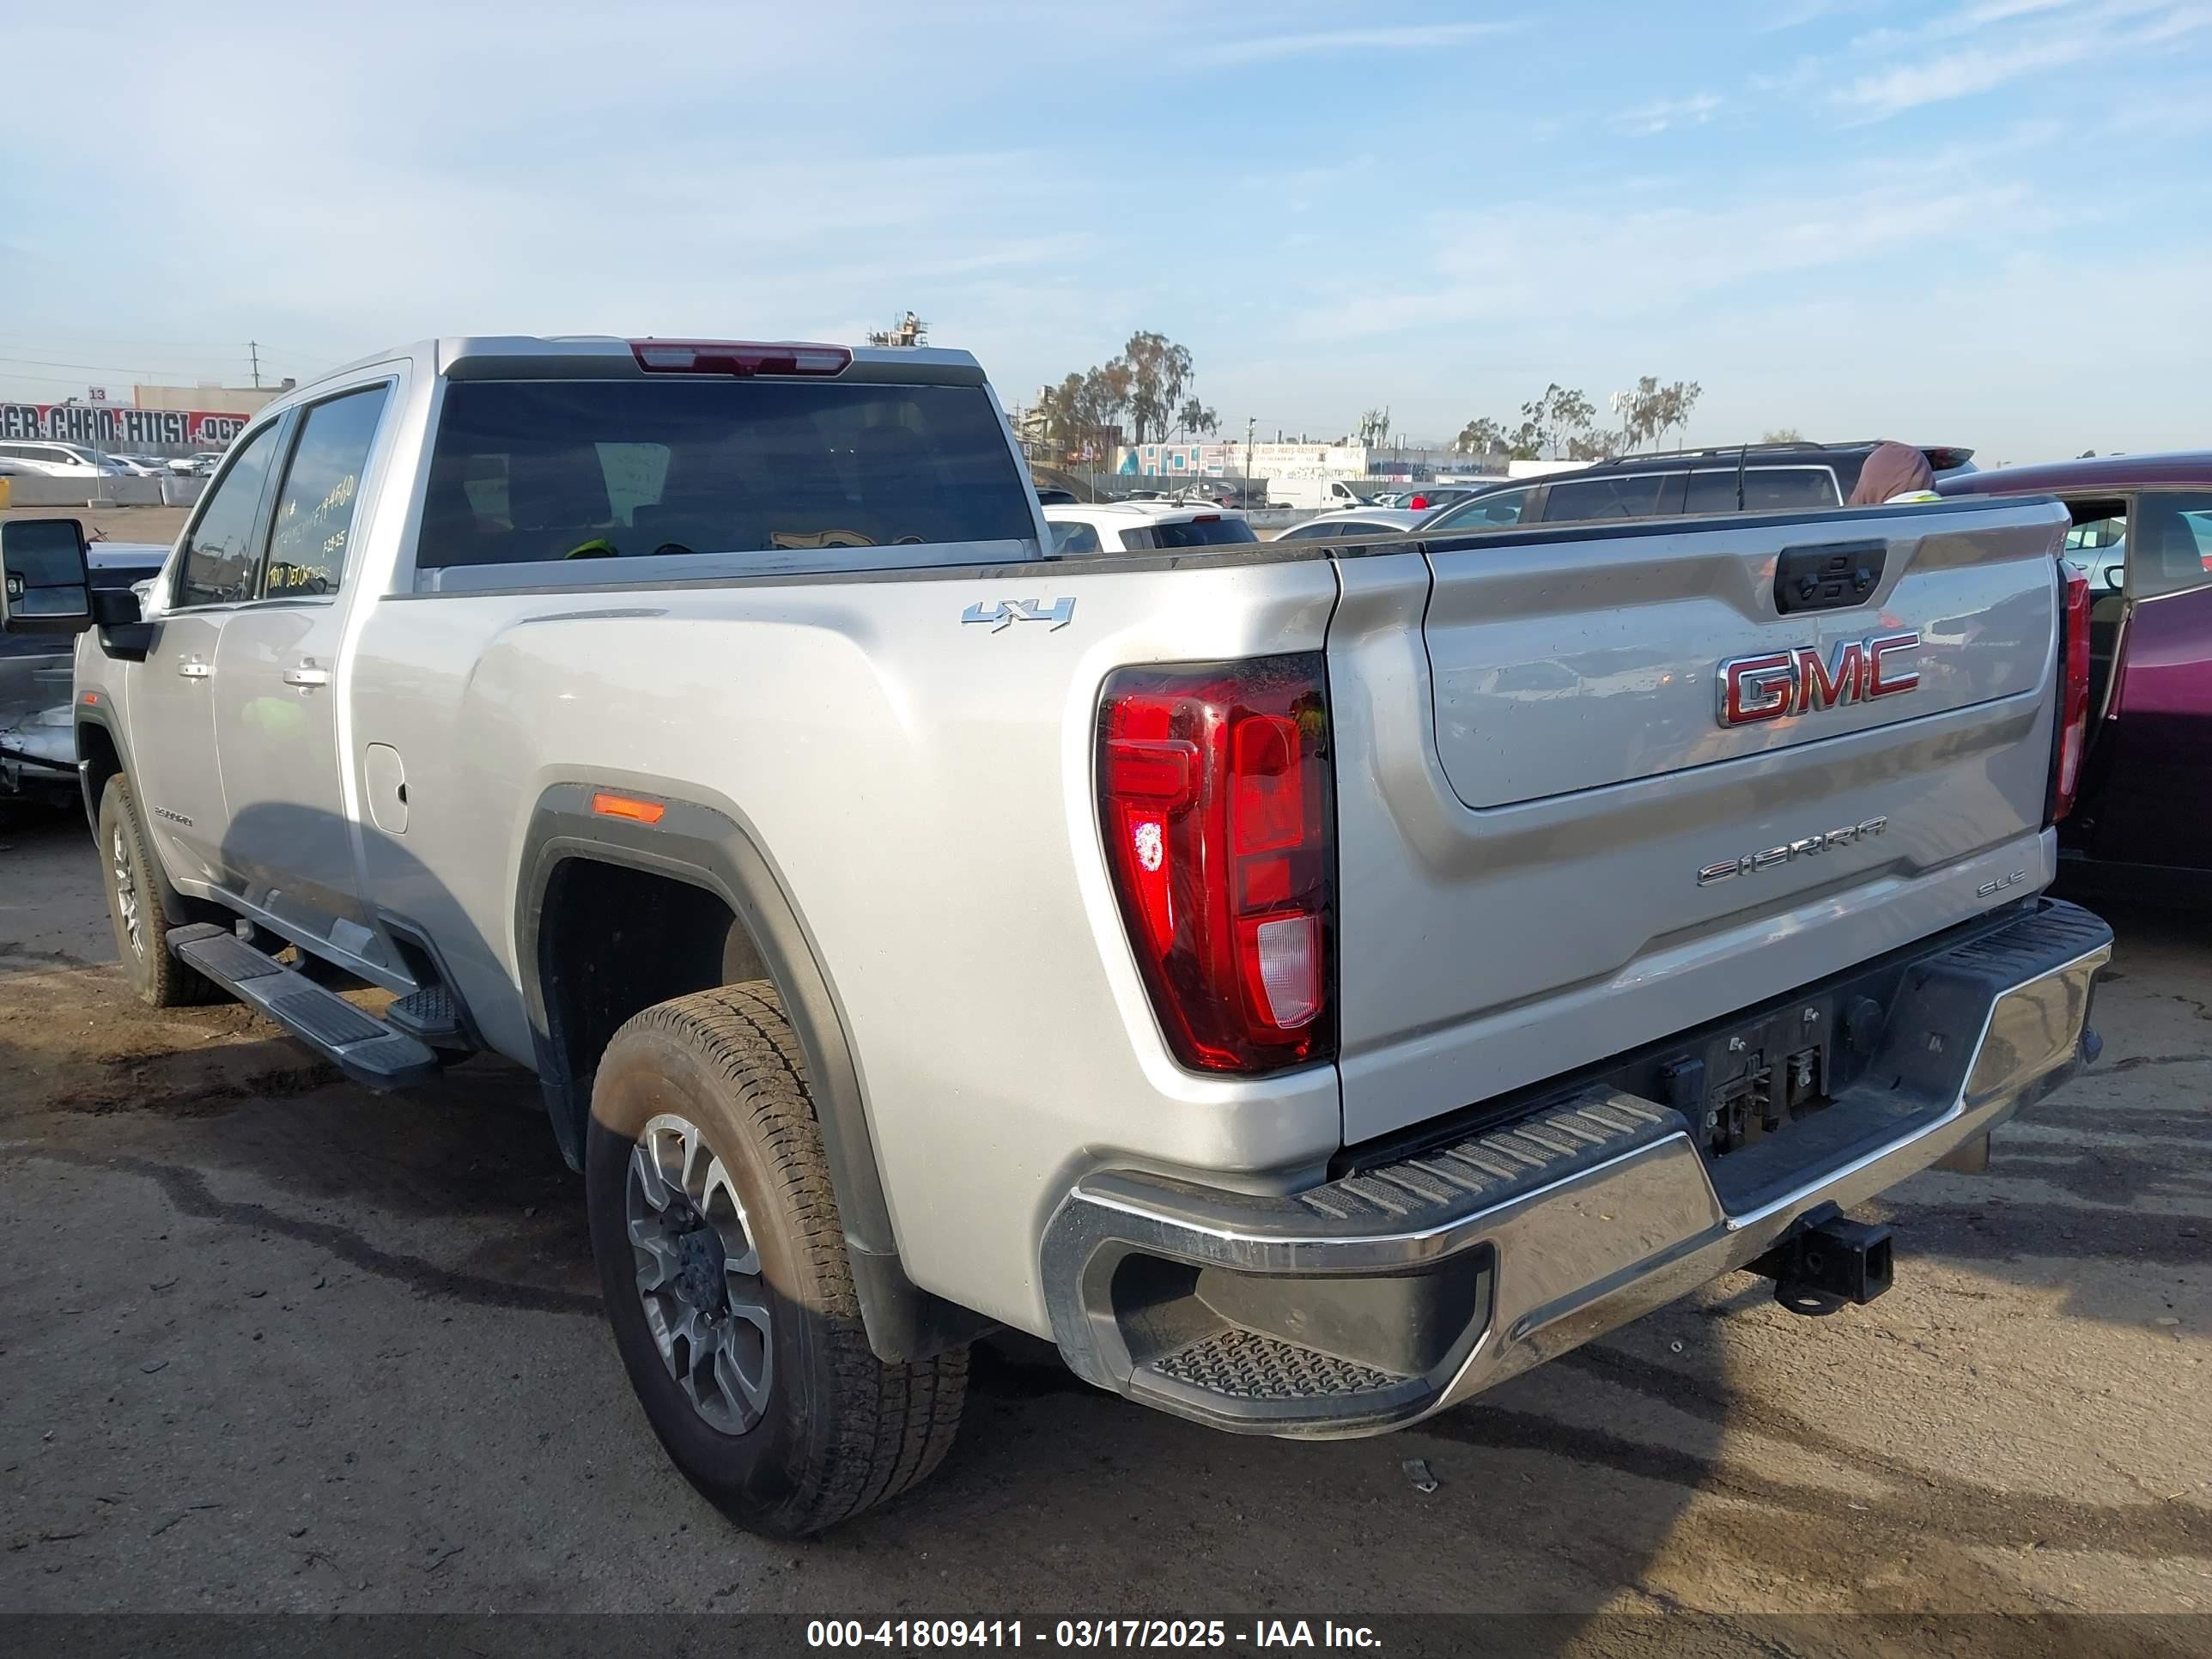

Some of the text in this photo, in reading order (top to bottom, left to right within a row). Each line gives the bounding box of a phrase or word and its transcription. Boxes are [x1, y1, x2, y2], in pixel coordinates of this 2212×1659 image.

[90, 389, 106, 400] 13
[1297, 446, 1328, 454] RADIATORS
[1717, 632, 1921, 729] GMC
[1697, 816, 1887, 887] SIERRA
